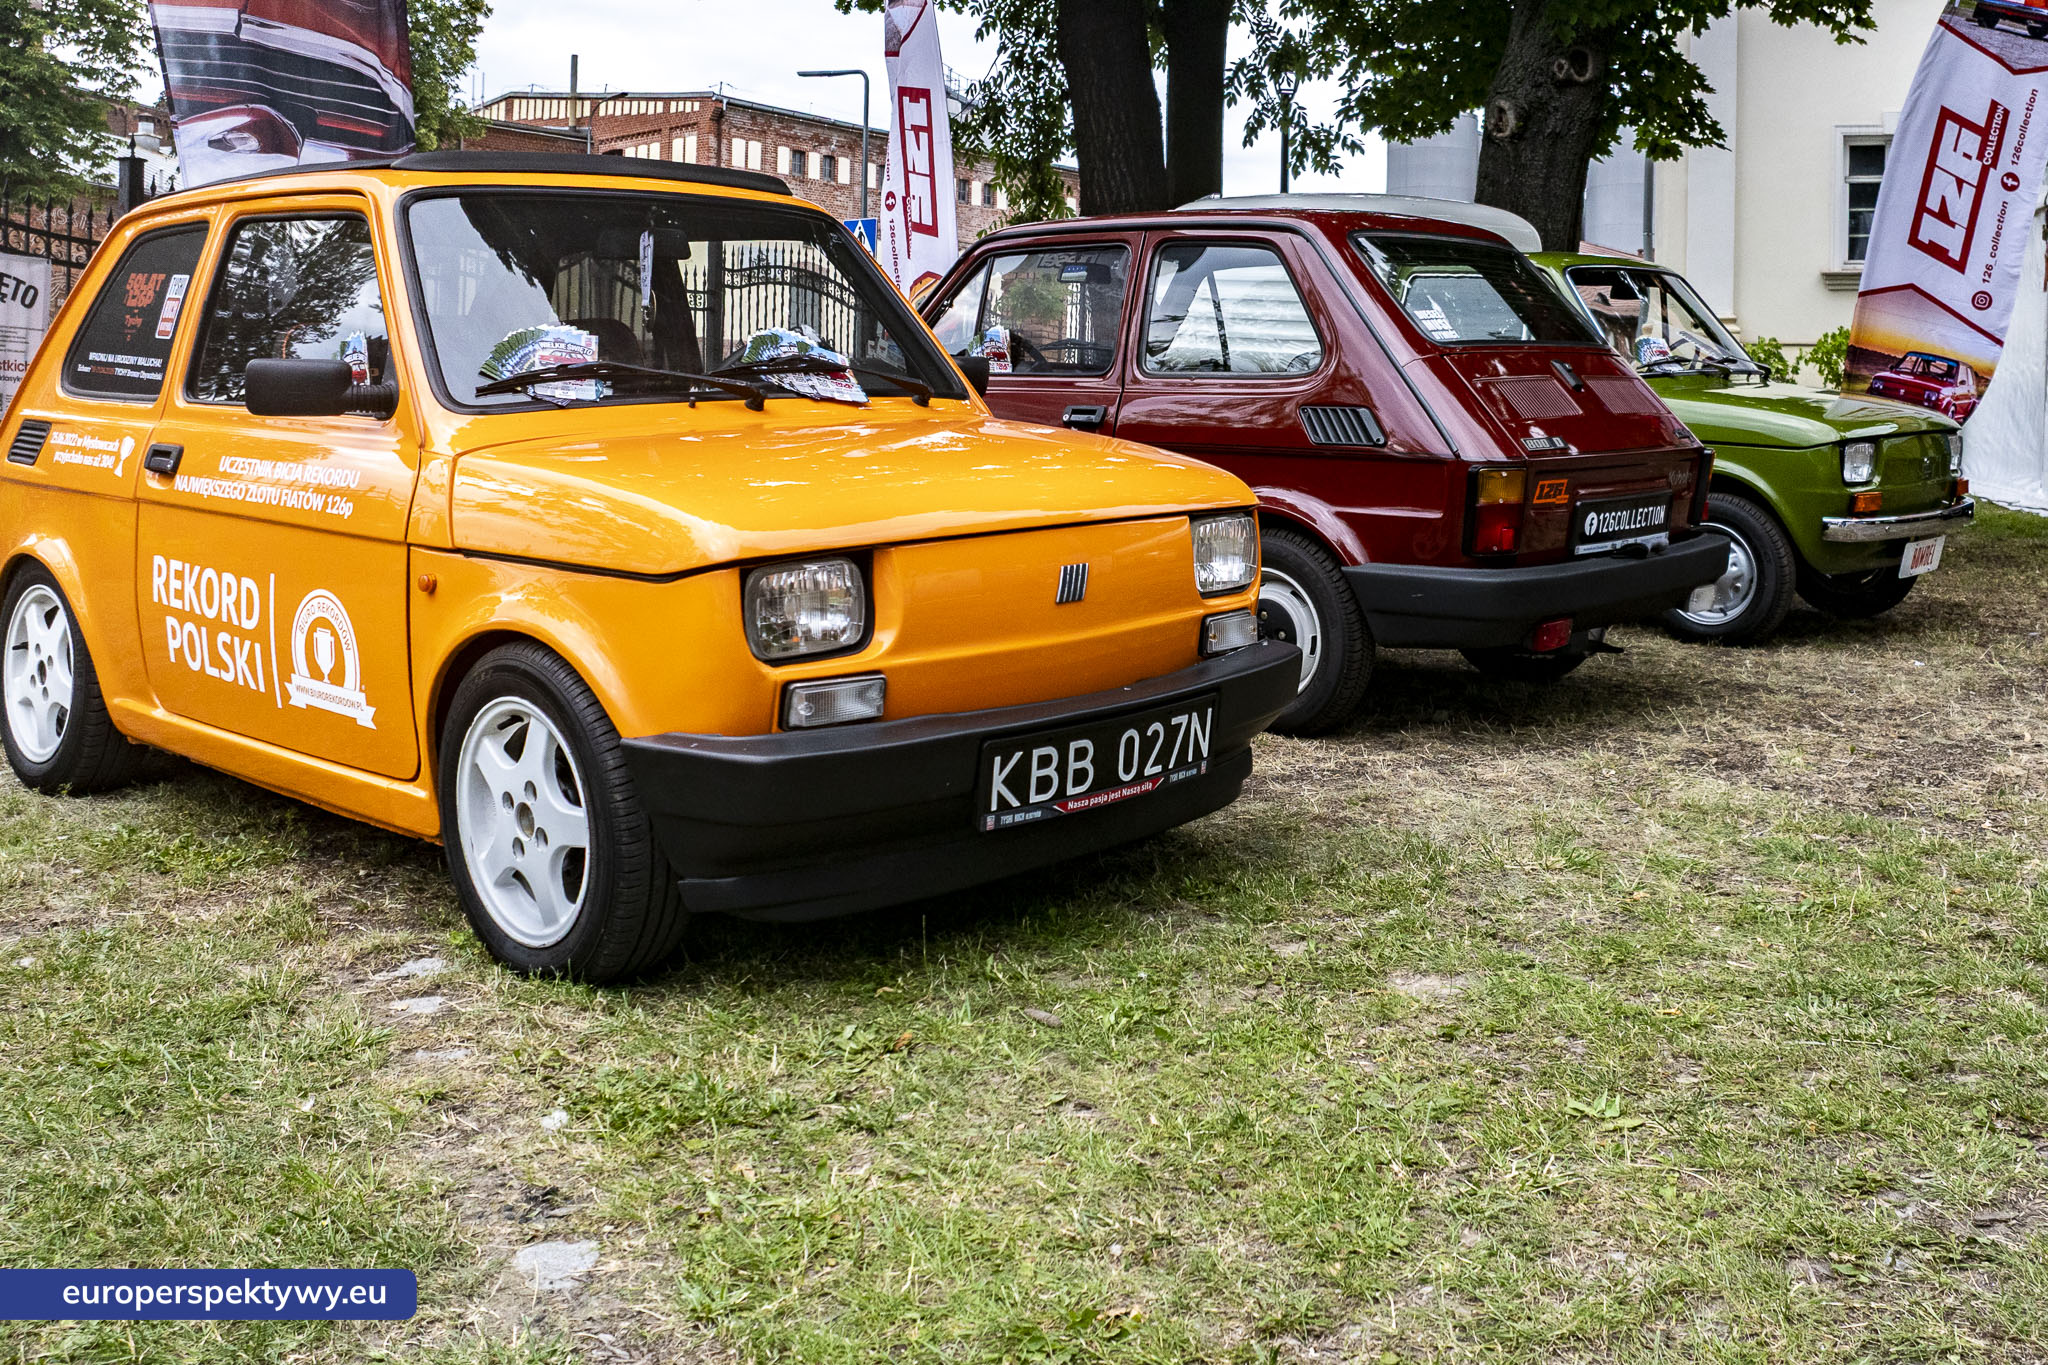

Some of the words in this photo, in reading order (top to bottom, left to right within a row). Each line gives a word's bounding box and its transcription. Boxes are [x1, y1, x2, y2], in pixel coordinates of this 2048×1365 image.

[1982, 104, 2005, 166] COLLECTION
[2011, 88, 2039, 167] 126collection
[539, 341, 567, 350] WIELKIE
[1525, 438, 1550, 449] 800
[1552, 437, 1565, 447] D
[218, 455, 274, 478] UCZESTNIK
[273, 461, 304, 481] BICIA
[303, 466, 361, 489] REKORDU
[174, 474, 246, 500] NAJWIĘKSZEGO
[245, 484, 282, 505] ZLOTU
[280, 487, 326, 512] FIATÓW
[325, 495, 354, 519] 126p
[1535, 482, 1564, 500] 126
[1599, 504, 1666, 534] 126COLLECTION
[152, 554, 260, 630] REKORD
[298, 603, 317, 635] BIURO
[165, 615, 266, 693] POLSKI
[990, 738, 1095, 812] KBB
[1117, 707, 1213, 783] 027N
[1067, 798, 1089, 810] Nasza
[1089, 793, 1108, 807] pasja
[1108, 790, 1122, 802] jest
[1122, 785, 1141, 797] Naszą
